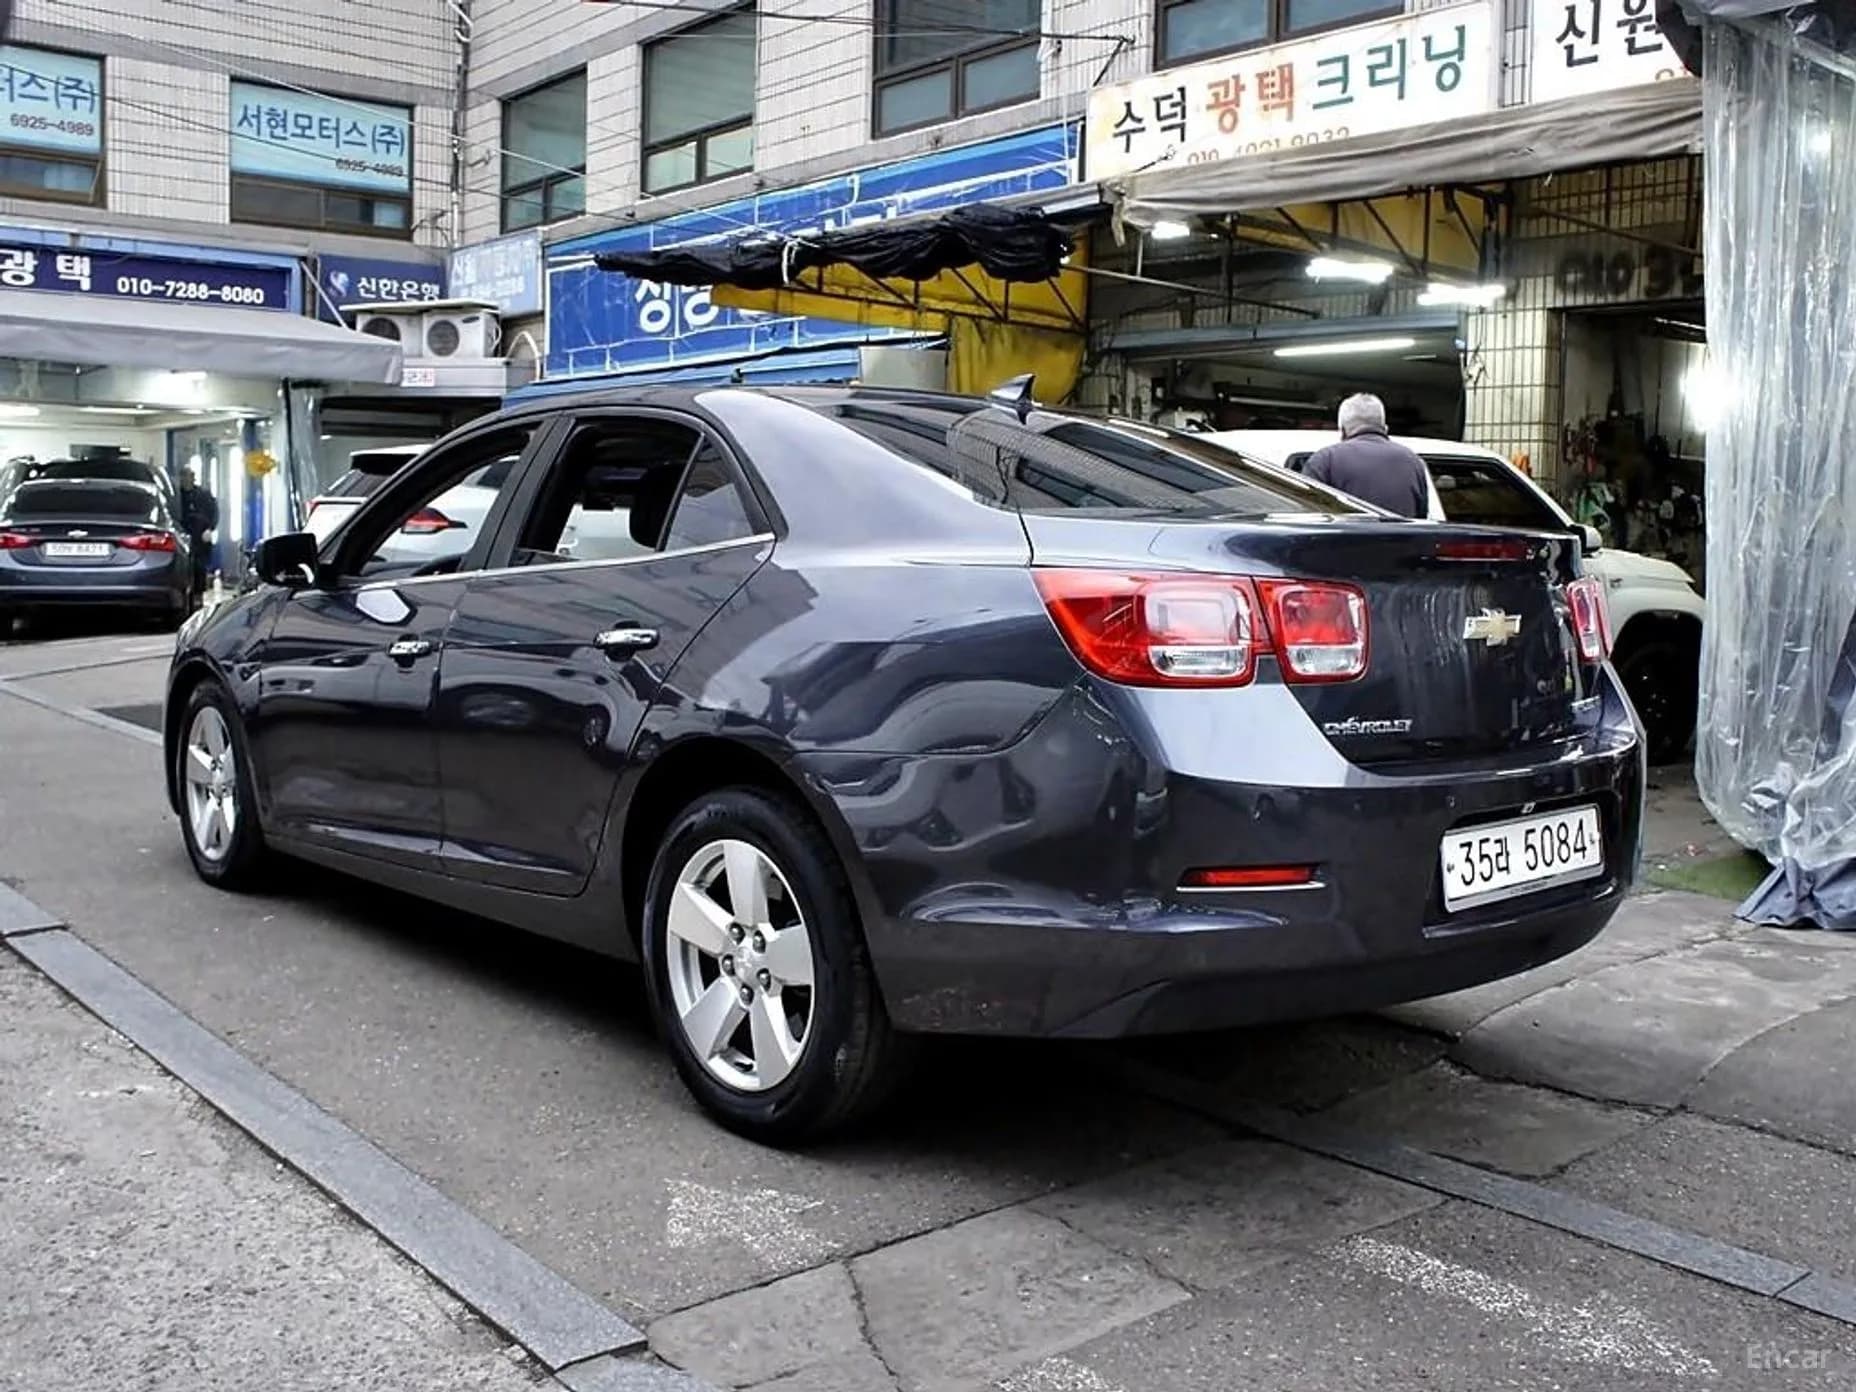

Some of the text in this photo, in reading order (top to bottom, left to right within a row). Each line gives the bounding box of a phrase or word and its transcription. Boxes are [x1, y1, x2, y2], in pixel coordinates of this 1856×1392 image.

[1112, 24, 1466, 153] 수덕 광택 크리닝
[10, 113, 94, 136] 6925-4989
[237, 103, 405, 157] 서현모터스(주)
[117, 276, 264, 304] 010-7288-8080
[357, 277, 440, 301] 신한은행
[1458, 817, 1588, 887] 35라 5084
